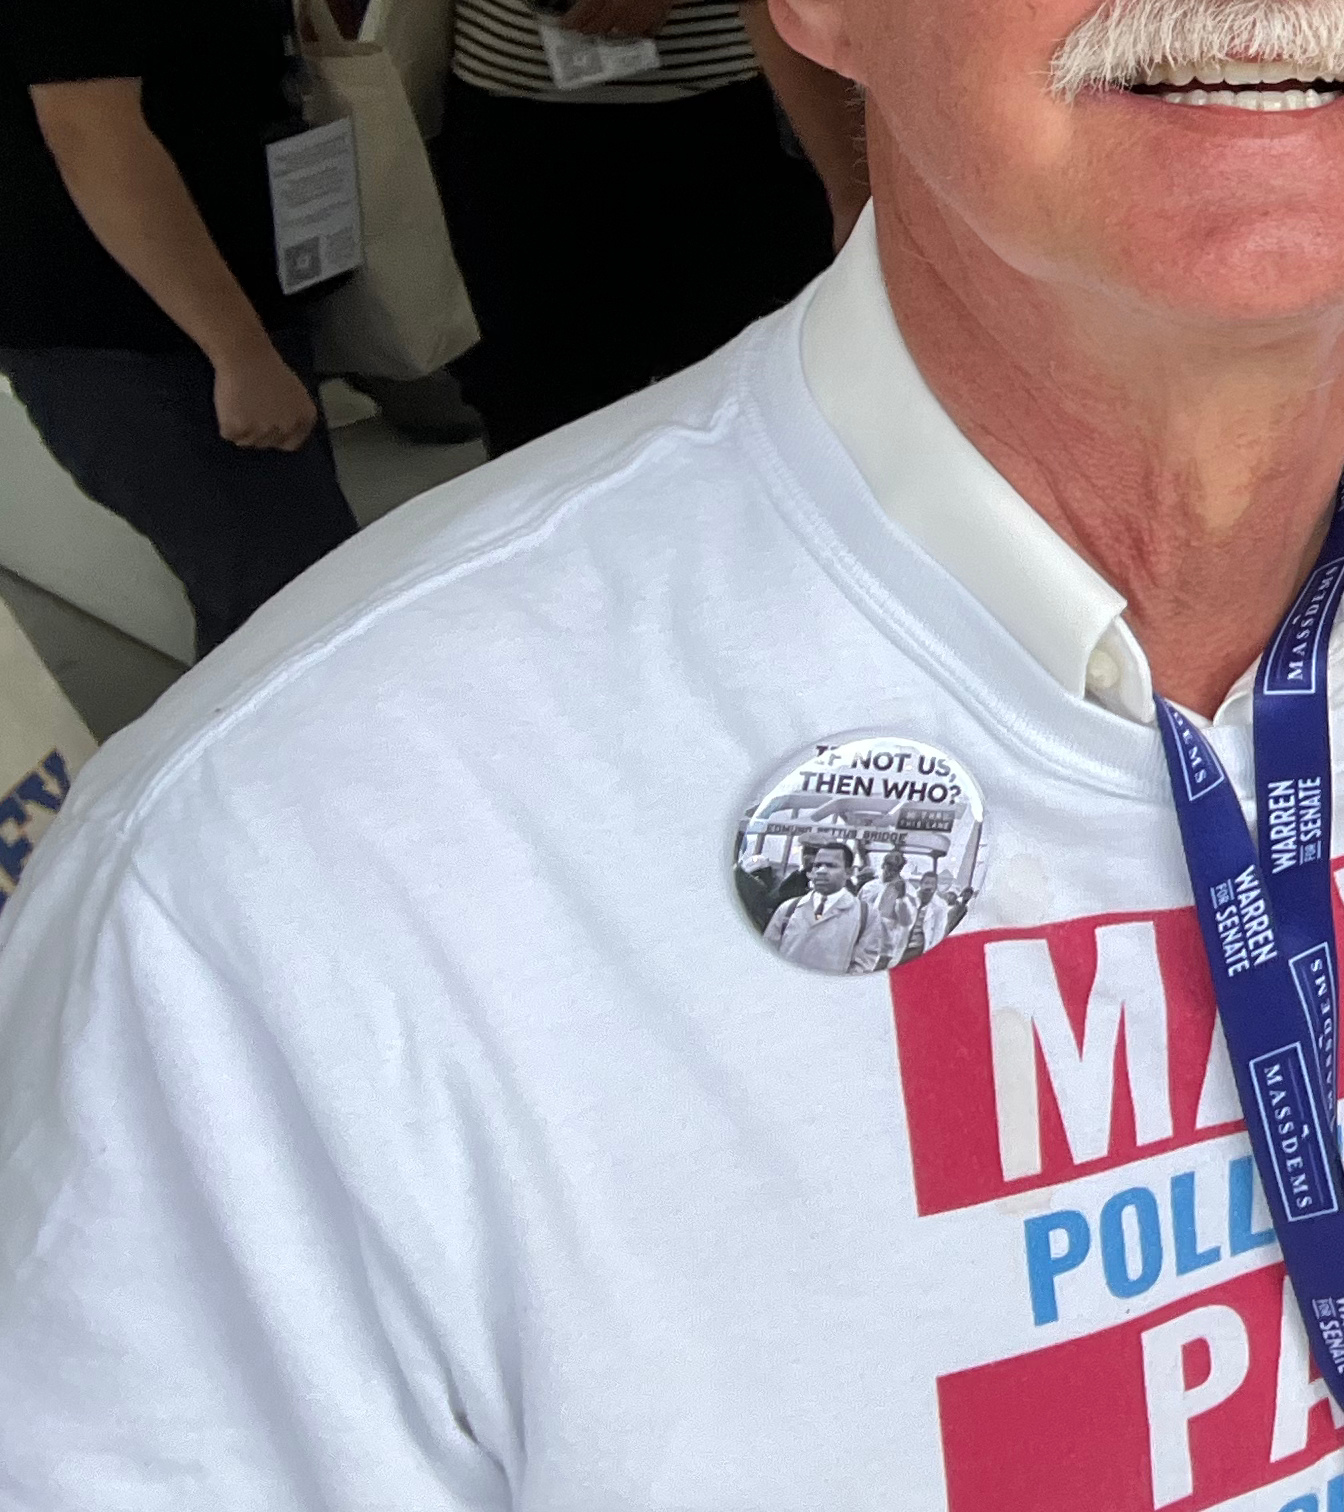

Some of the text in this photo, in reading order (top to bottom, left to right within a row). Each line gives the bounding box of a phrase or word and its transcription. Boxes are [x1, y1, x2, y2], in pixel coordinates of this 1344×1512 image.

[1286, 564, 1340, 682] MASSDEMS
[799, 771, 963, 807] THEN WHO?
[850, 751, 912, 772] NOT
[917, 755, 958, 784] US,
[1267, 778, 1296, 875] WARREN
[1298, 776, 1322, 863] FOR SENATE
[1213, 883, 1249, 978] FOR SENATE
[1234, 864, 1278, 969] WARREN
[1263, 1062, 1314, 1210] MASSDEMS
